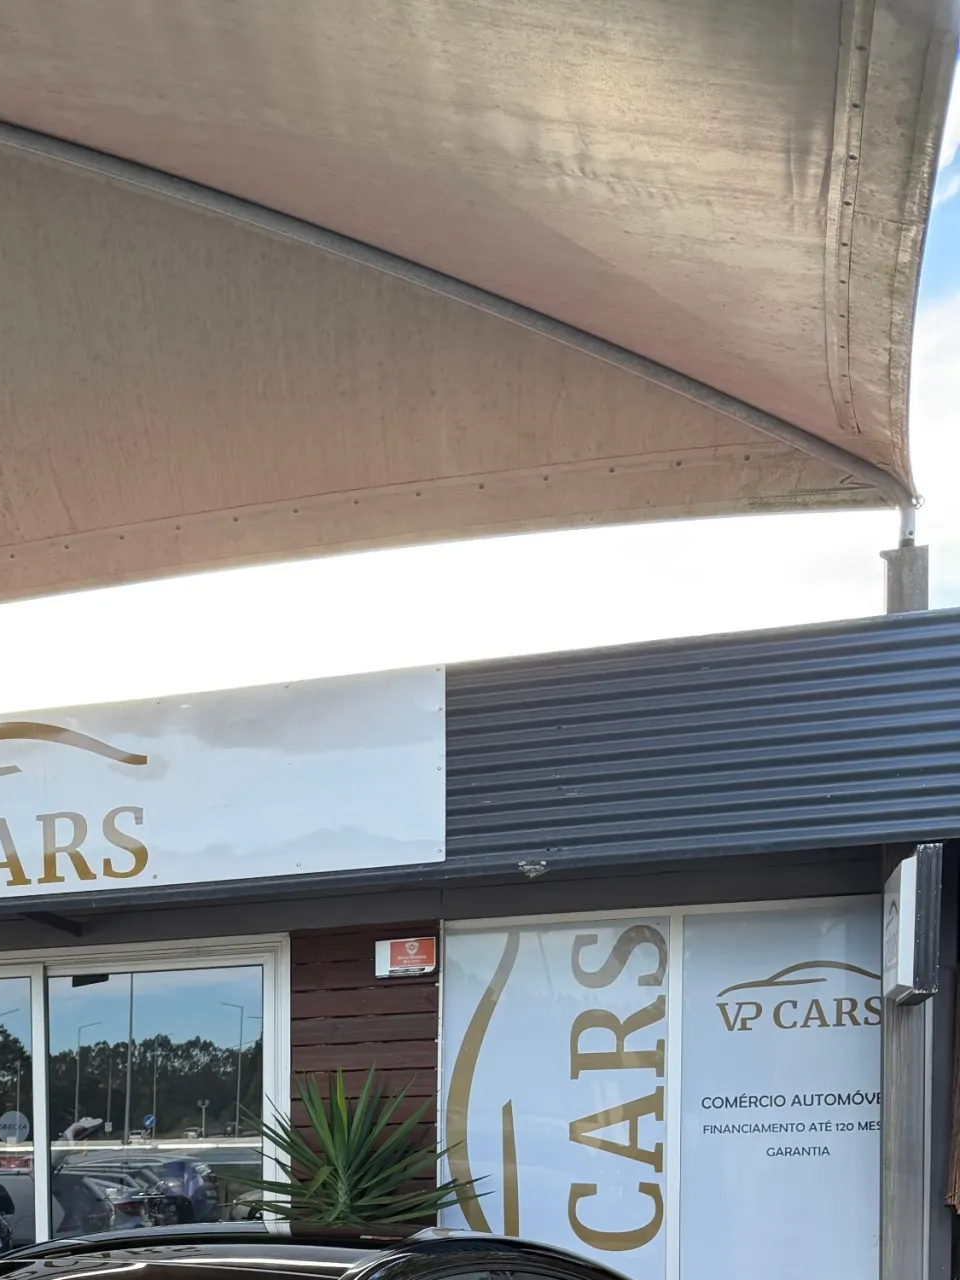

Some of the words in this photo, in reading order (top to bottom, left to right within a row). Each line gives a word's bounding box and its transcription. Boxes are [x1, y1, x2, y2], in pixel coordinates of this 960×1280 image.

[716, 1001, 763, 1032] VP
[773, 995, 882, 1030] CARS
[568, 924, 668, 1252] CARS
[701, 1093, 786, 1110] COMÉRCIO
[702, 1122, 806, 1135] FINANCIAMENTO
[808, 1119, 832, 1132] ATÉ
[835, 1122, 855, 1132] 120
[766, 1146, 831, 1157] GARANTIA
